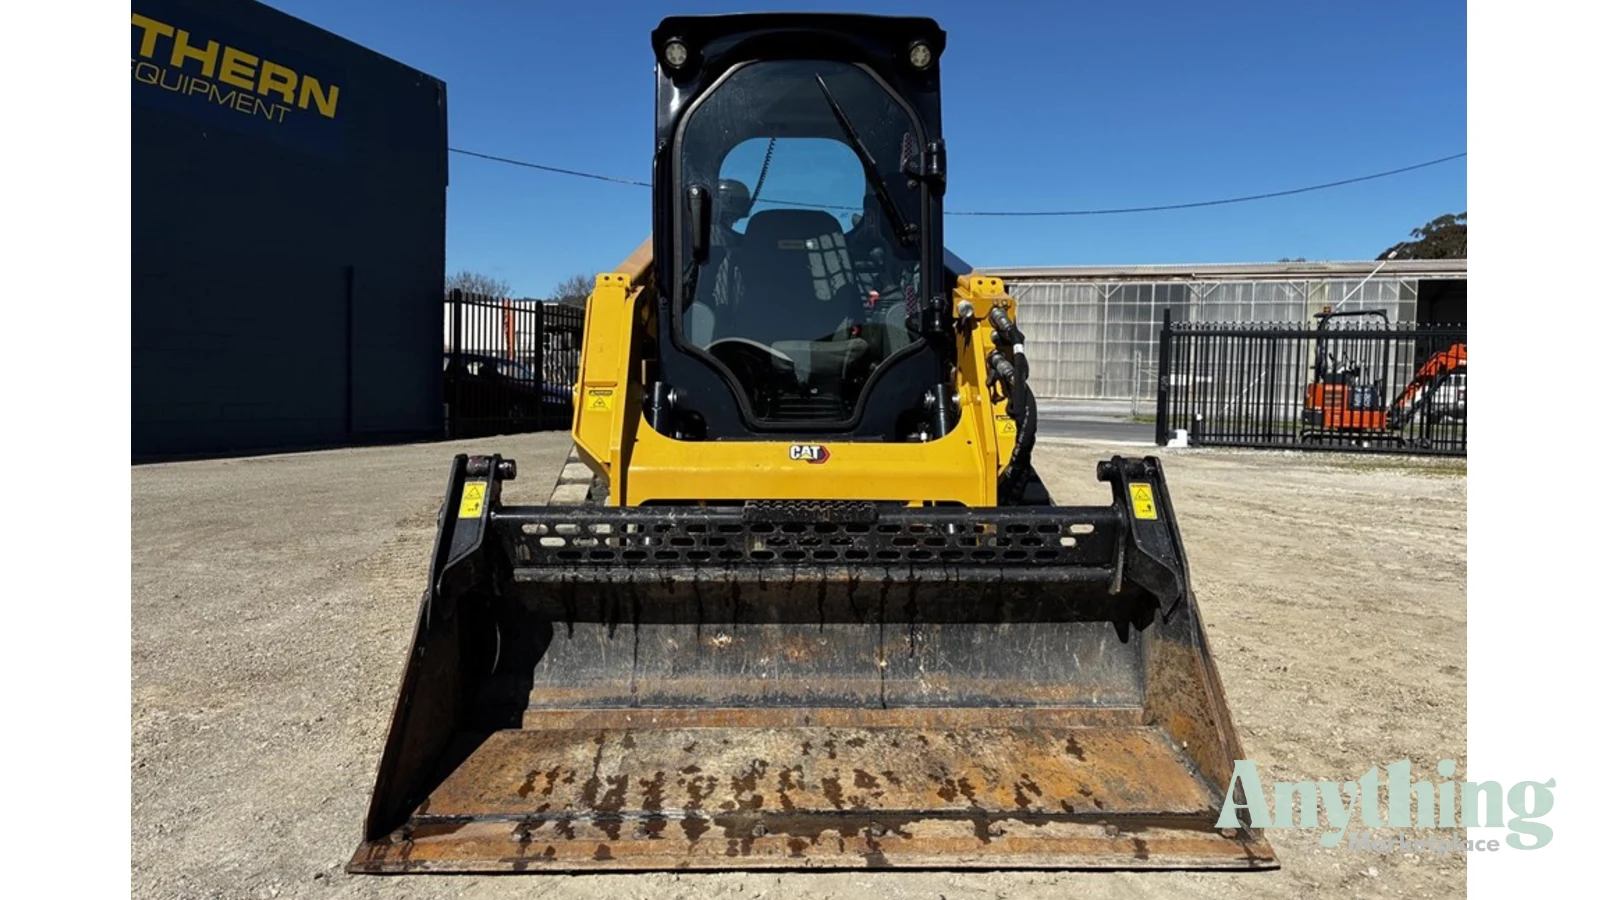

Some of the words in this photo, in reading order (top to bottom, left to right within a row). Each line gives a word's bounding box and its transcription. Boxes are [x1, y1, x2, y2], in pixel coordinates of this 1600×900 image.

[131, 13, 340, 118] THERN
[131, 58, 292, 124] QUIPMENT
[790, 445, 820, 460] CAT
